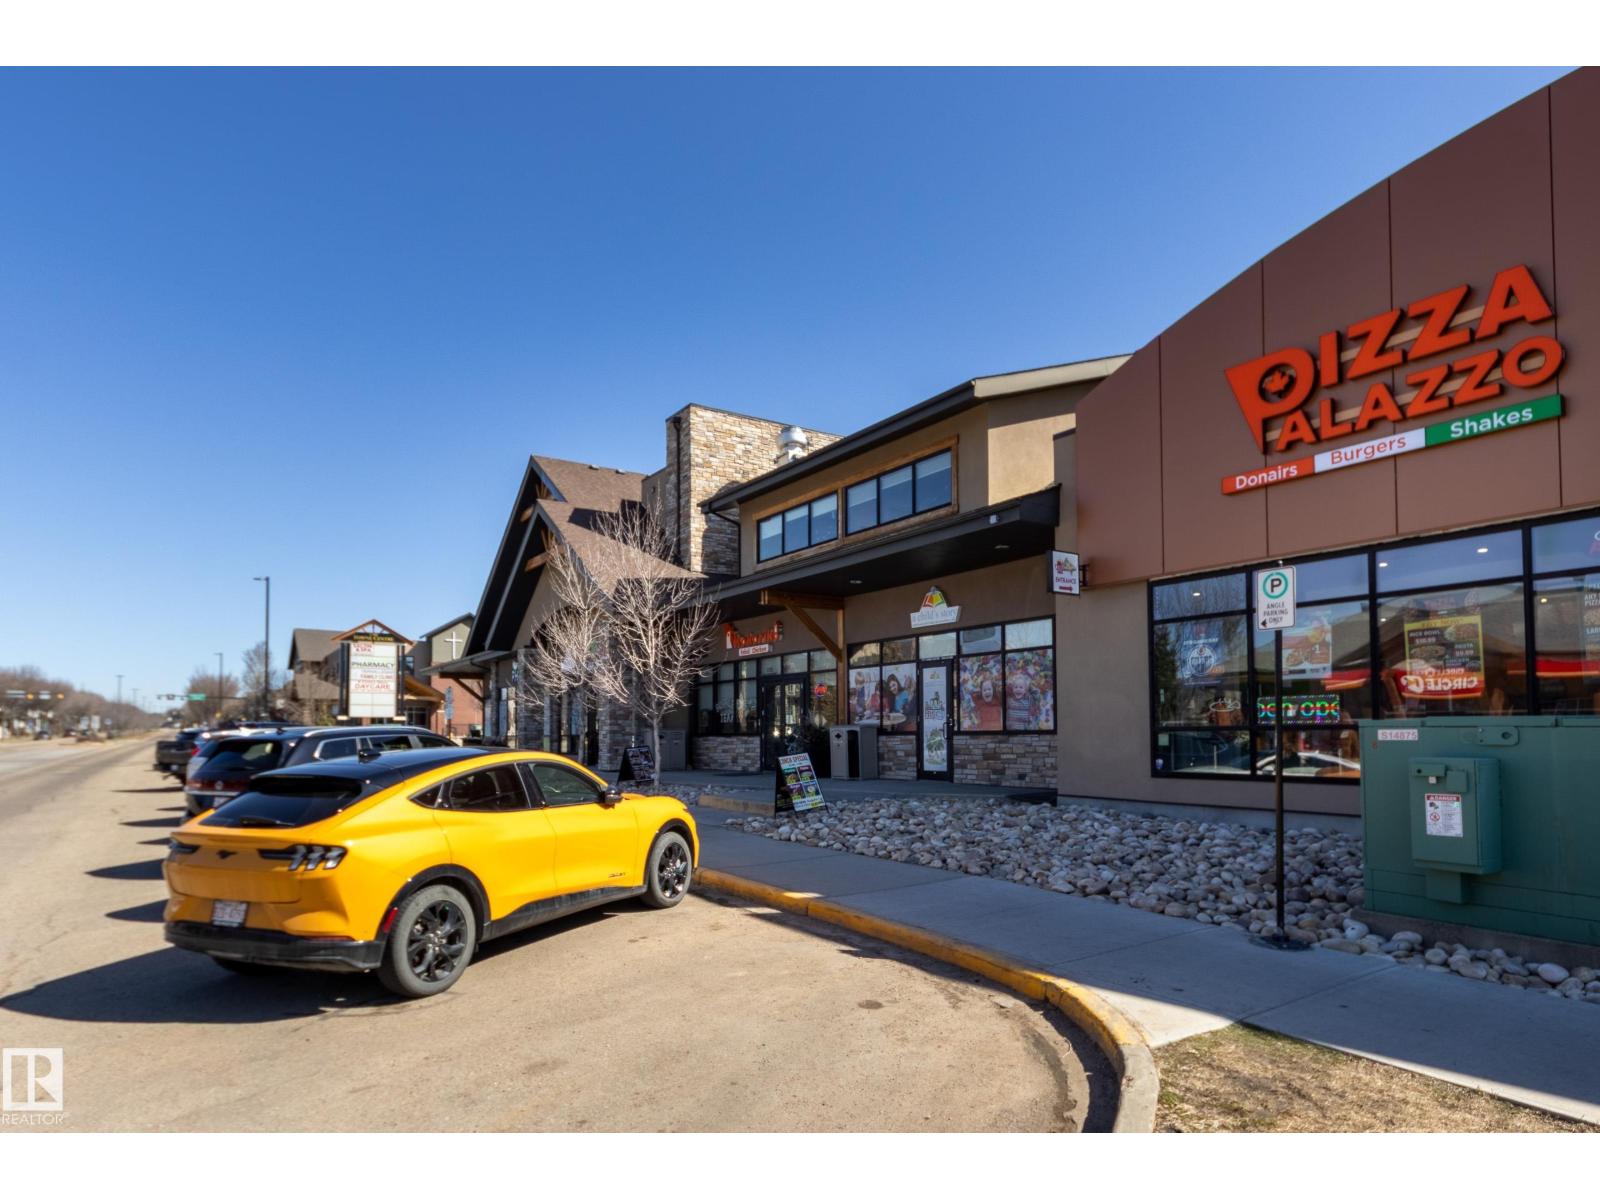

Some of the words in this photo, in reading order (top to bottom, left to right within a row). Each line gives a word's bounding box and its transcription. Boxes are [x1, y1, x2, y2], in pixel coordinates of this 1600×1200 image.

[1235, 463, 1298, 490] Donairs
[1330, 434, 1407, 466] Burgers
[1450, 405, 1533, 439] Shakes
[1270, 578, 1282, 593] P
[1268, 616, 1284, 624] ONLY
